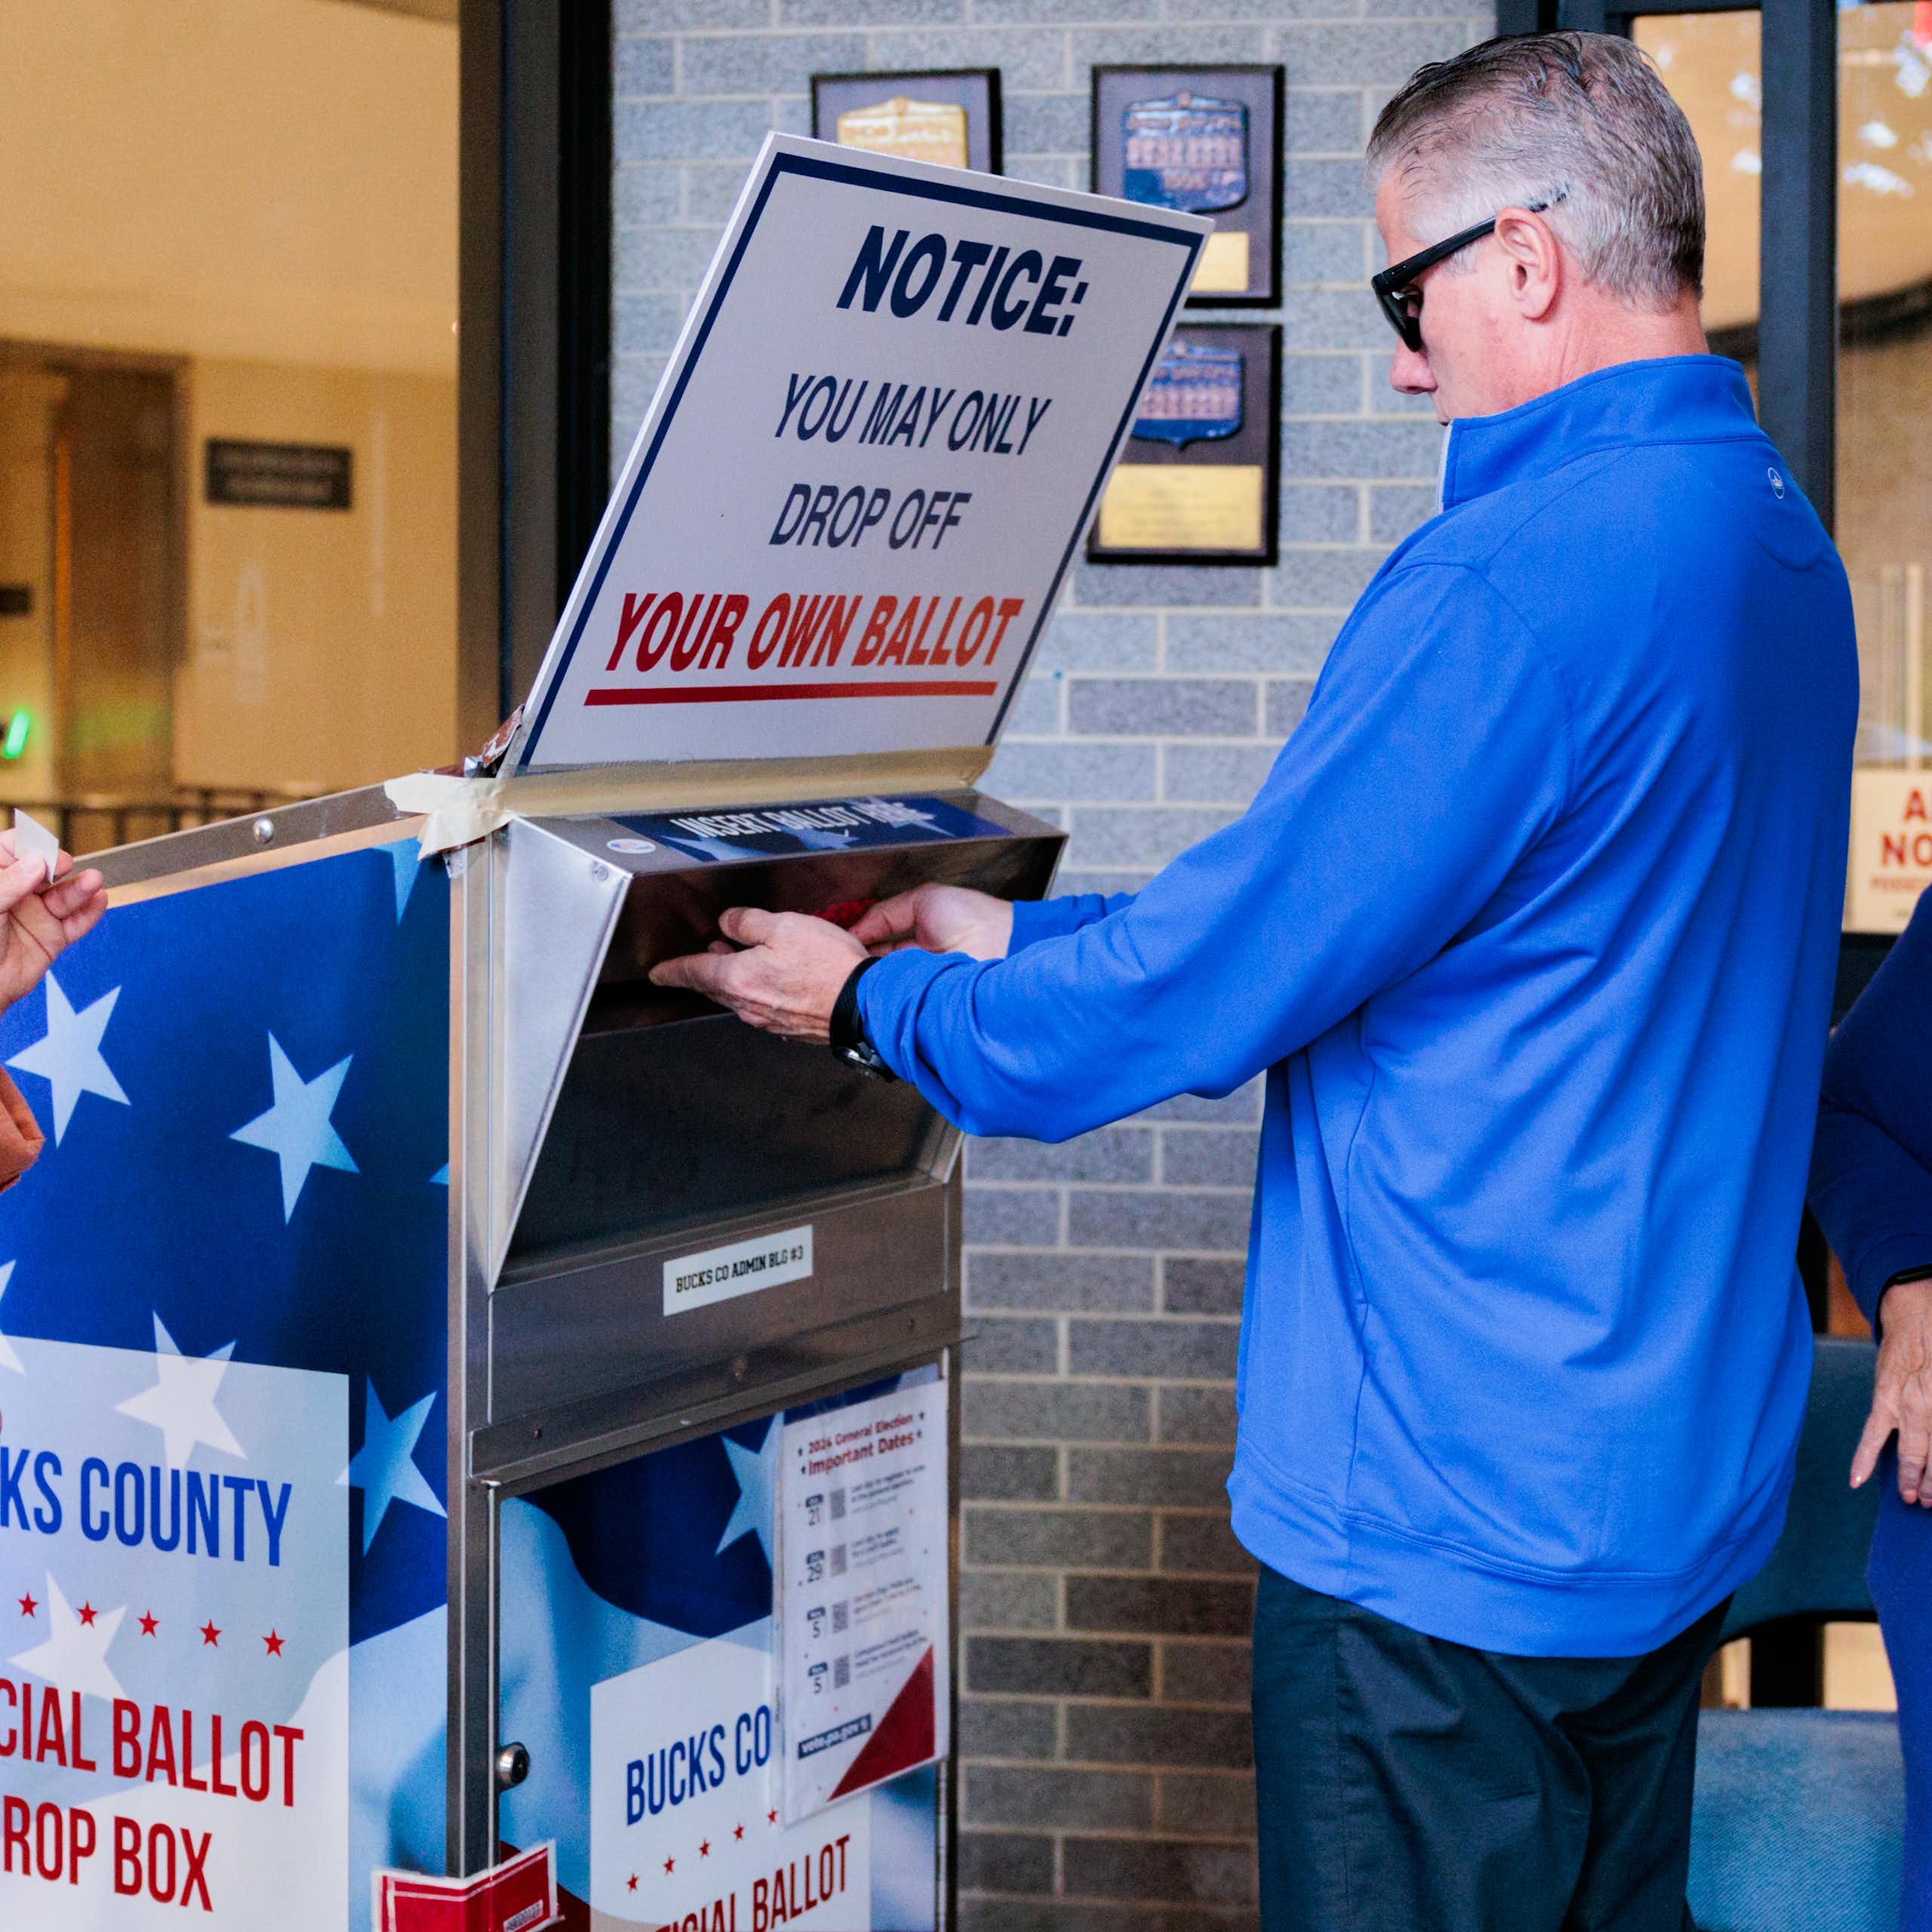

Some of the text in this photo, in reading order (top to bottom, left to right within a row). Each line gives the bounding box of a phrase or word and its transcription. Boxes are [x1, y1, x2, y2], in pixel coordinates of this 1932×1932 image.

[835, 225, 1089, 337] NOTICE:
[774, 373, 1052, 455] YOU MAY ONLY
[768, 483, 972, 550] DROP OFF
[605, 591, 1025, 672] YOUR OWN BALLOT
[669, 813, 782, 838] INSERT
[761, 806, 872, 830] BALLOT
[675, 1244, 804, 1293] BUCKS CO ADMIN BLG #3
[808, 1412, 914, 1454] 2024 General Election
[808, 1432, 915, 1476] Important Dates
[80, 1457, 292, 1567] COUNTY
[814, 1676, 822, 1694] 5
[112, 1697, 304, 1807] BALLOT
[626, 1724, 725, 1826] BUCKS
[735, 1704, 771, 1775] CO
[114, 1815, 214, 1912] BOX
[752, 1834, 851, 1932] BALLOT
